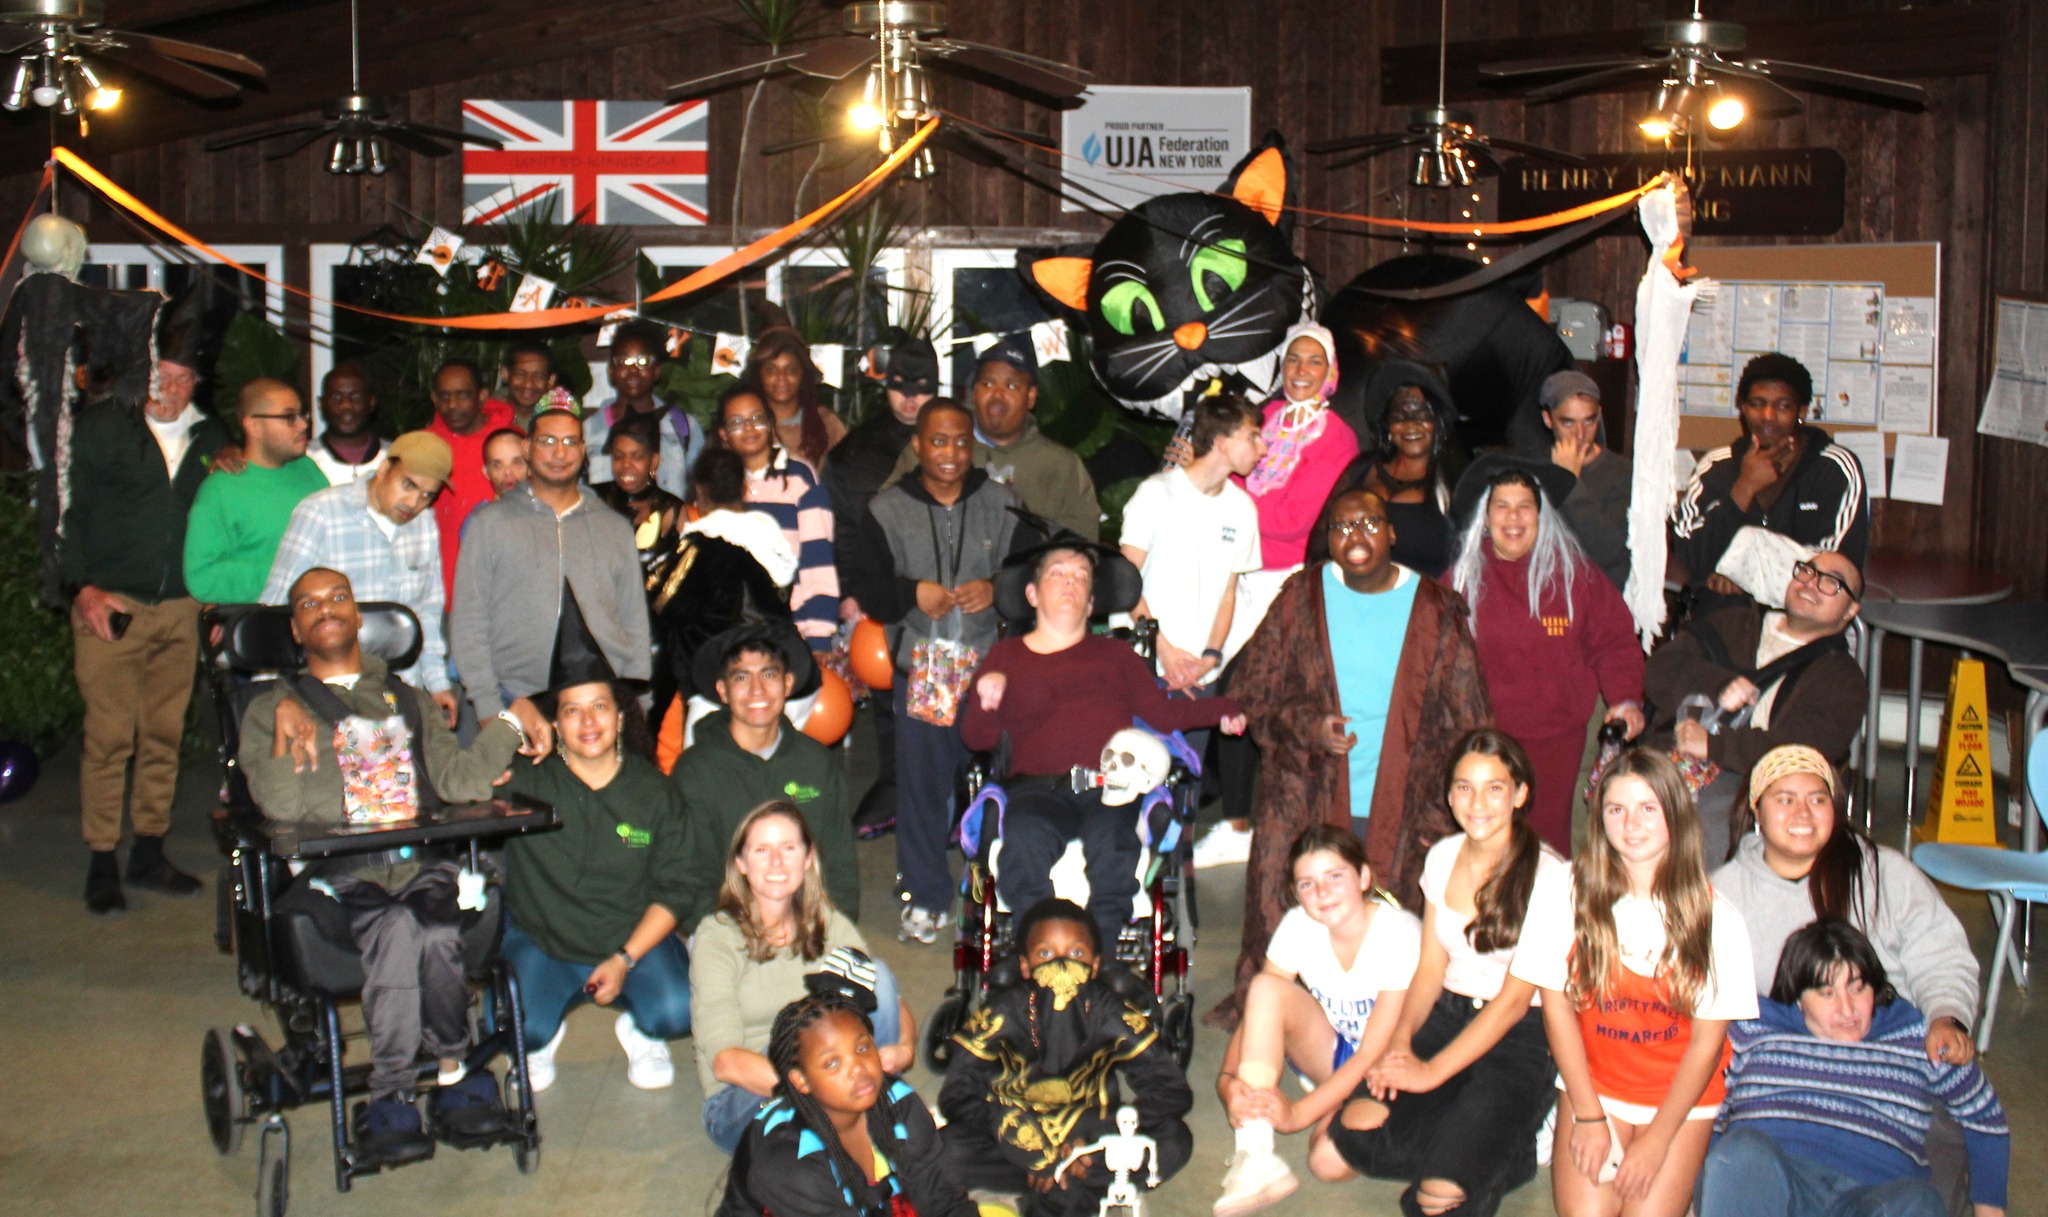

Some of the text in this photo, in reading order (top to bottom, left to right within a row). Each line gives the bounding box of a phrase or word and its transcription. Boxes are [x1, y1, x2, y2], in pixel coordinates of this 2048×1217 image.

[1105, 122, 1164, 131] PROUD PARTNER
[1159, 136, 1229, 152] Federation
[1105, 136, 1155, 168] UJA
[515, 156, 676, 168] UNITED KINGDOM
[1159, 155, 1223, 168] NEW YORK
[1521, 166, 1619, 191] HENRY
[1958, 742, 1983, 751] FLOOR
[1596, 1021, 1679, 1044] MONARCHS
